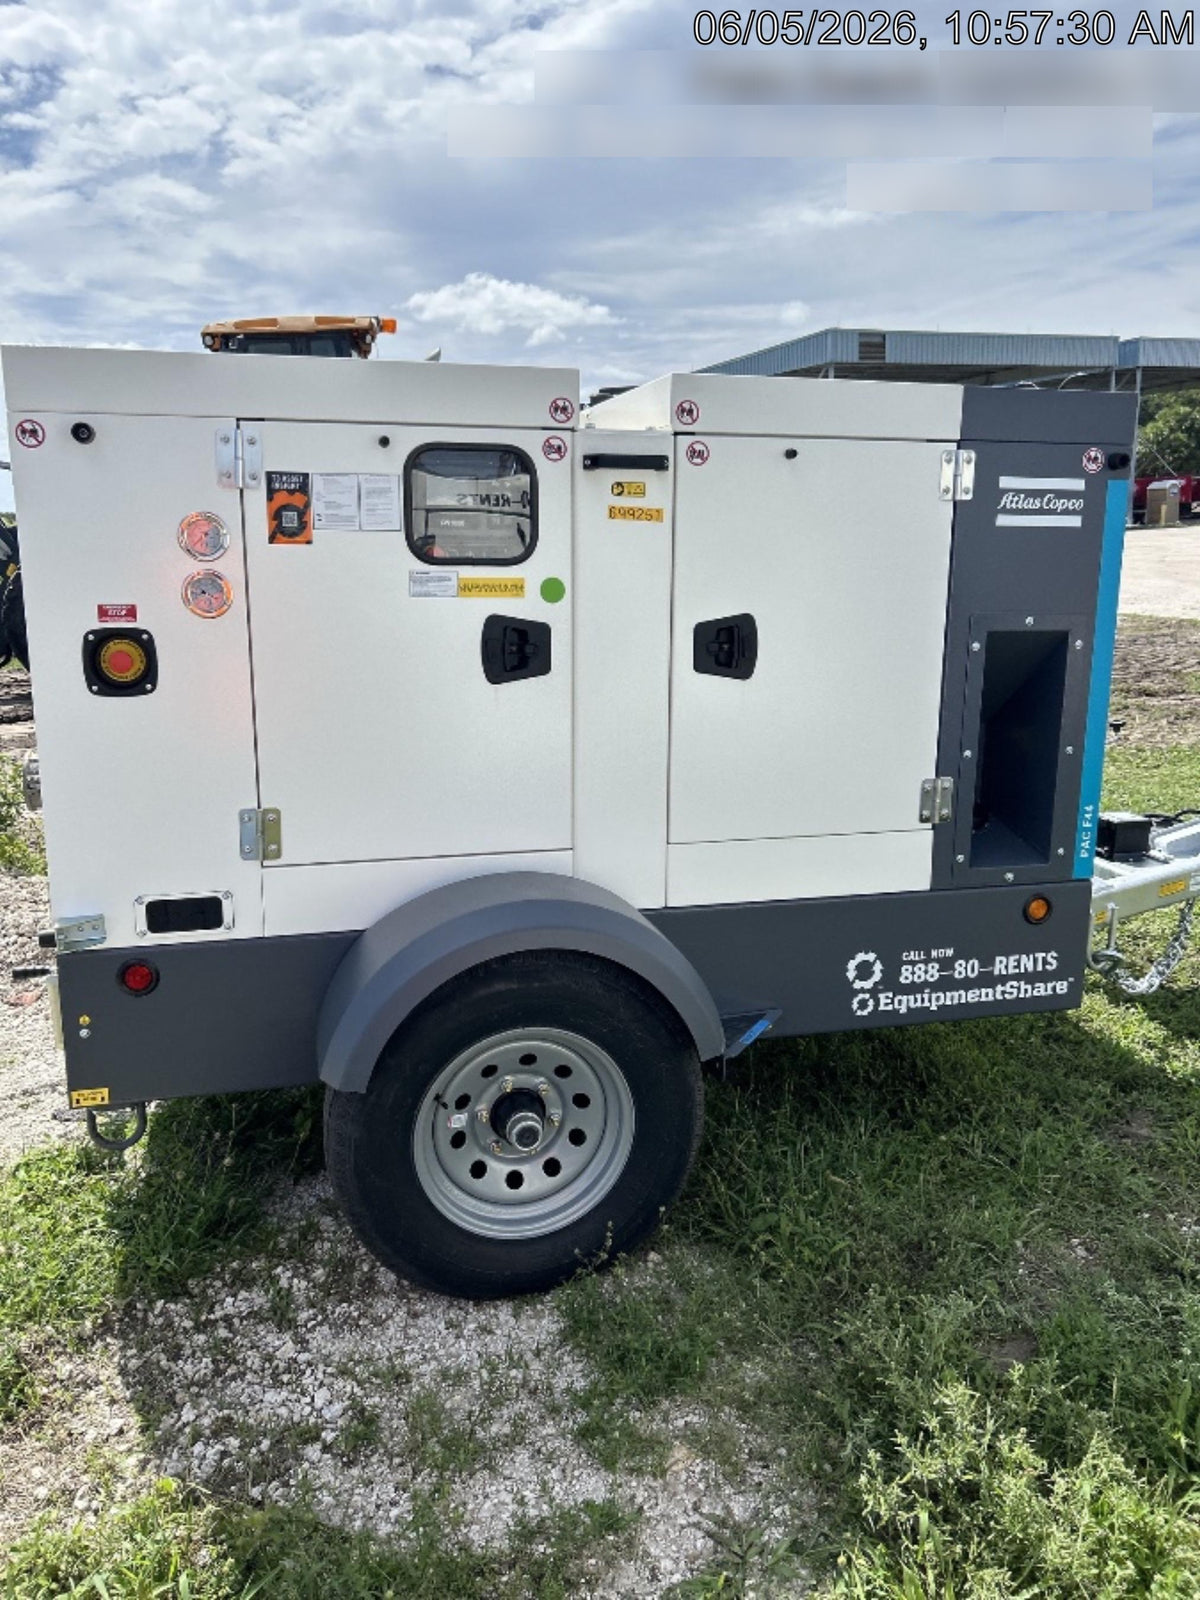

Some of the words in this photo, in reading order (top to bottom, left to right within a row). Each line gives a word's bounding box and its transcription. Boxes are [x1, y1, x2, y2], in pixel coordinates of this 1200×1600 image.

[997, 491, 1041, 509] Atlas
[1043, 493, 1084, 512] Copco
[1080, 831, 1092, 858] PAC
[902, 950, 926, 961] CALL
[931, 947, 954, 959] NOW
[878, 980, 1068, 1014] EquipmentShare
